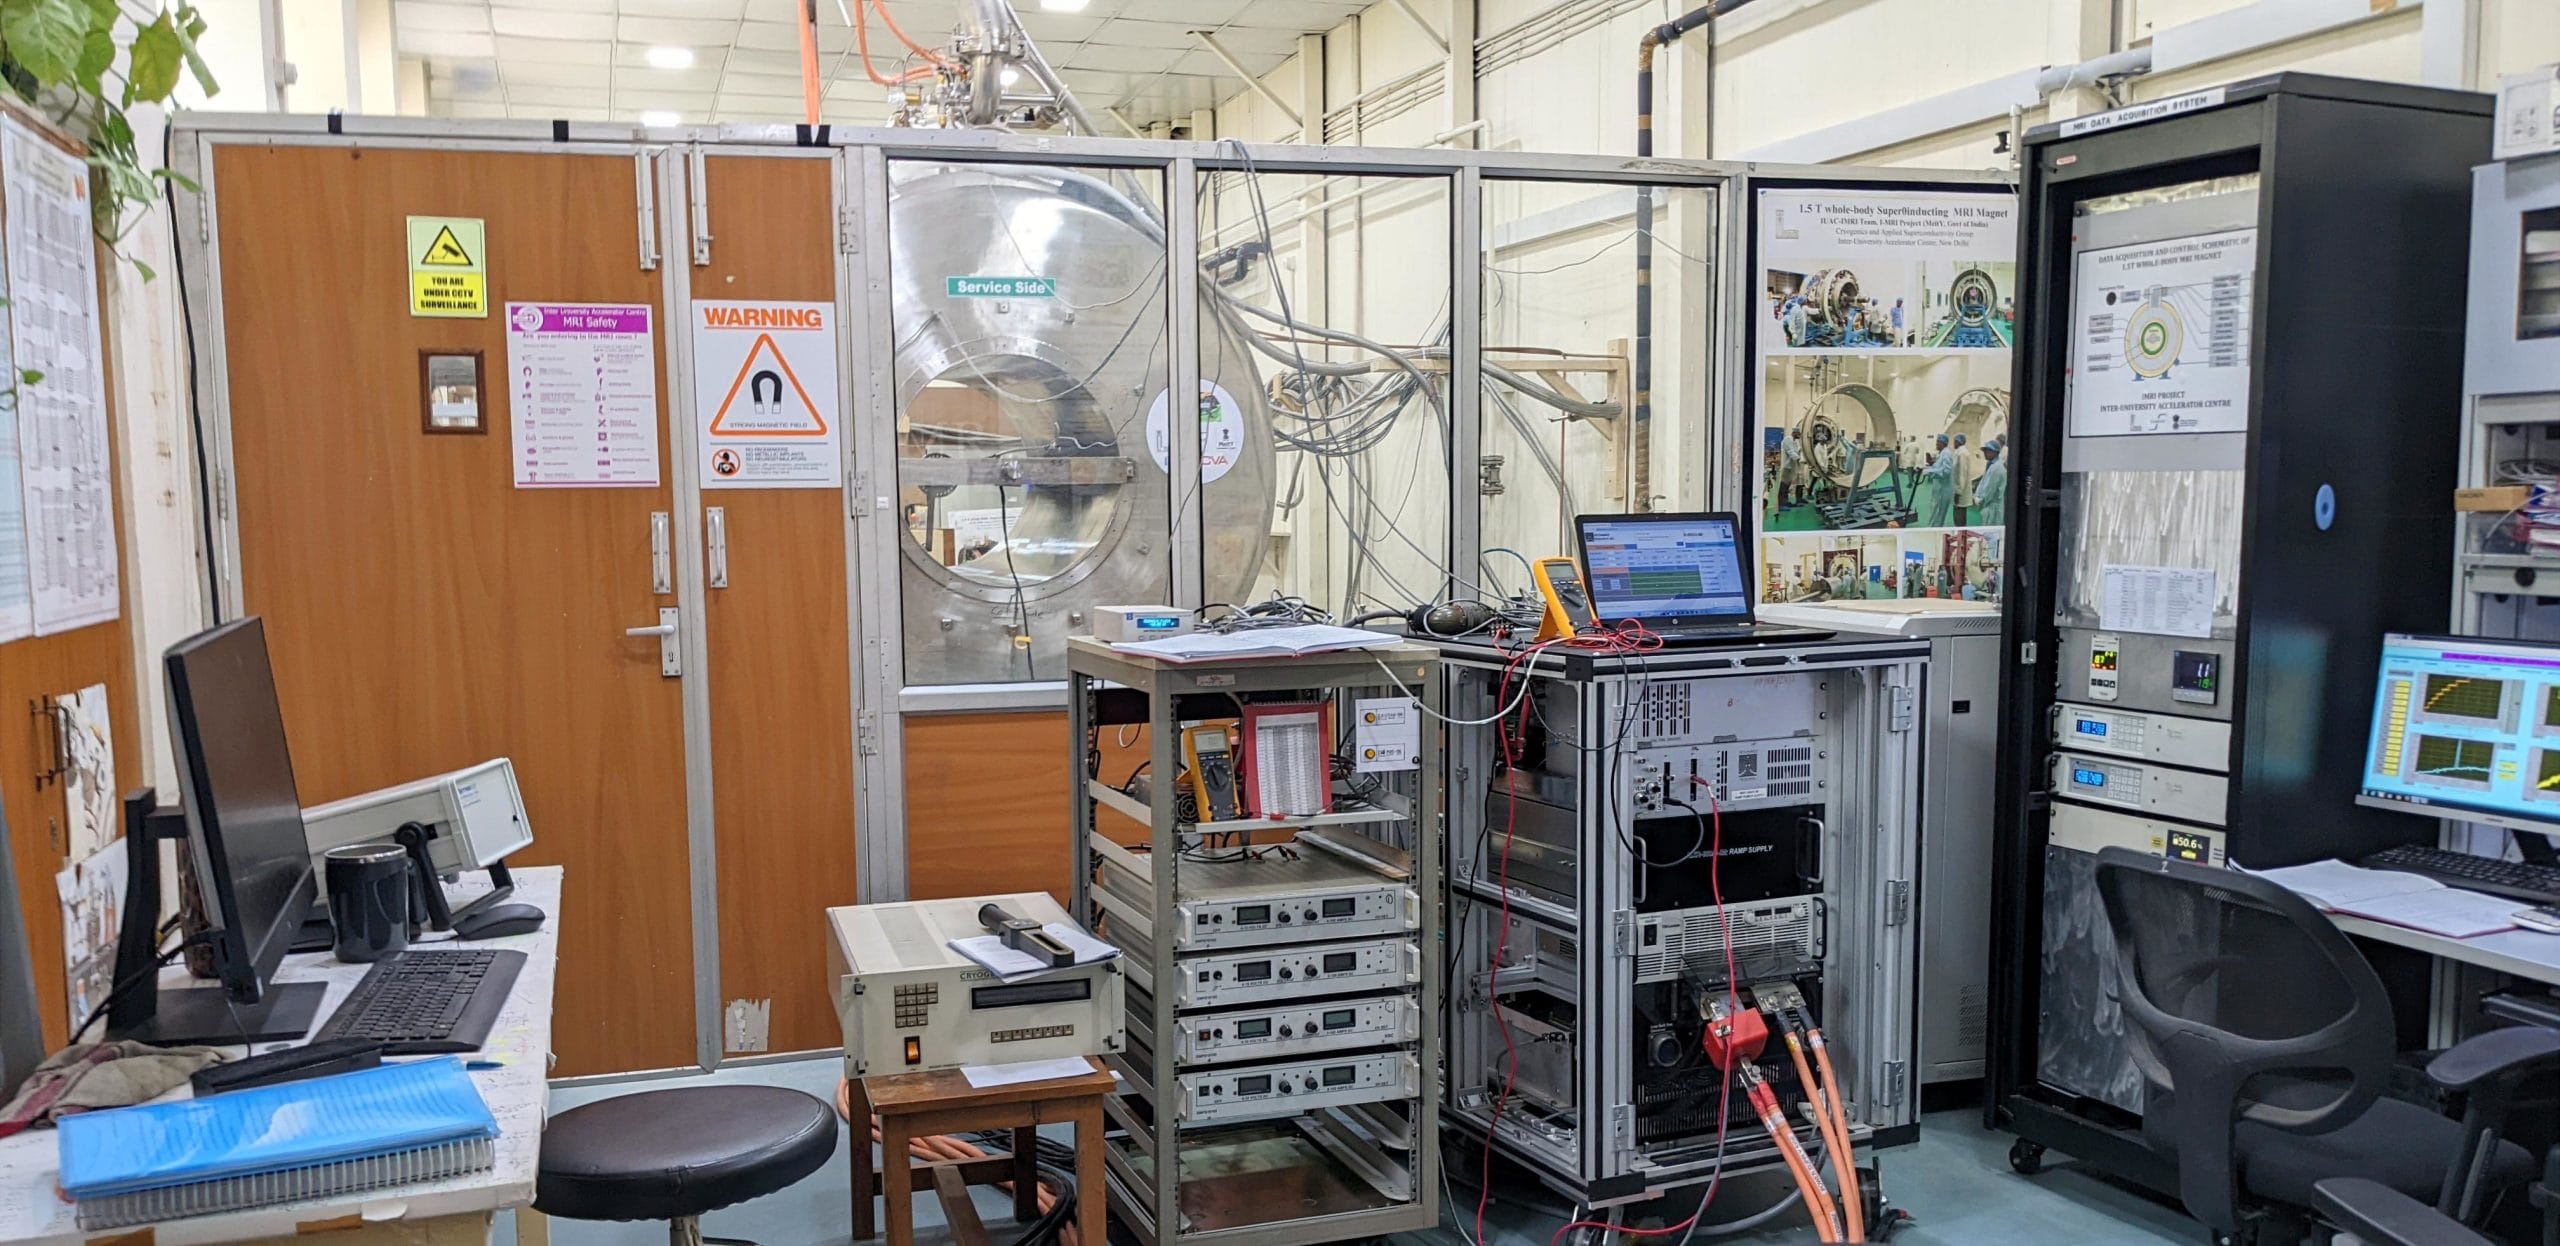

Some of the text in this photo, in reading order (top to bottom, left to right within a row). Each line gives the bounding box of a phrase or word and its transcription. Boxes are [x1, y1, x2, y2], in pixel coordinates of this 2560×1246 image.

[2073, 96, 2207, 131] MRI DATA ACQUISITION SYSTEM
[1799, 203, 1813, 214] 1.5
[1824, 204, 1875, 217] whole-body
[1953, 207, 1974, 217] MRI
[1976, 208, 2008, 219] Magnet
[1900, 219, 1921, 228] Project
[2194, 251, 2222, 261] MAGNET
[431, 277, 464, 286] YOU ARE
[957, 280, 1046, 294] Service Side
[423, 289, 474, 298] UNDER CCTV
[420, 300, 477, 309] SURVEILLANCE
[543, 306, 646, 317] Inter University Accelerator Centre
[563, 316, 618, 330] MRI Safety
[703, 307, 822, 328] WARNING
[2157, 390, 2186, 400] PROJECT
[2100, 399, 2232, 413] INTER-UNIVERSITY ACCELERATOR CENTRE
[1728, 847, 1748, 856] RAMP
[1748, 844, 1774, 854] SUPPLY
